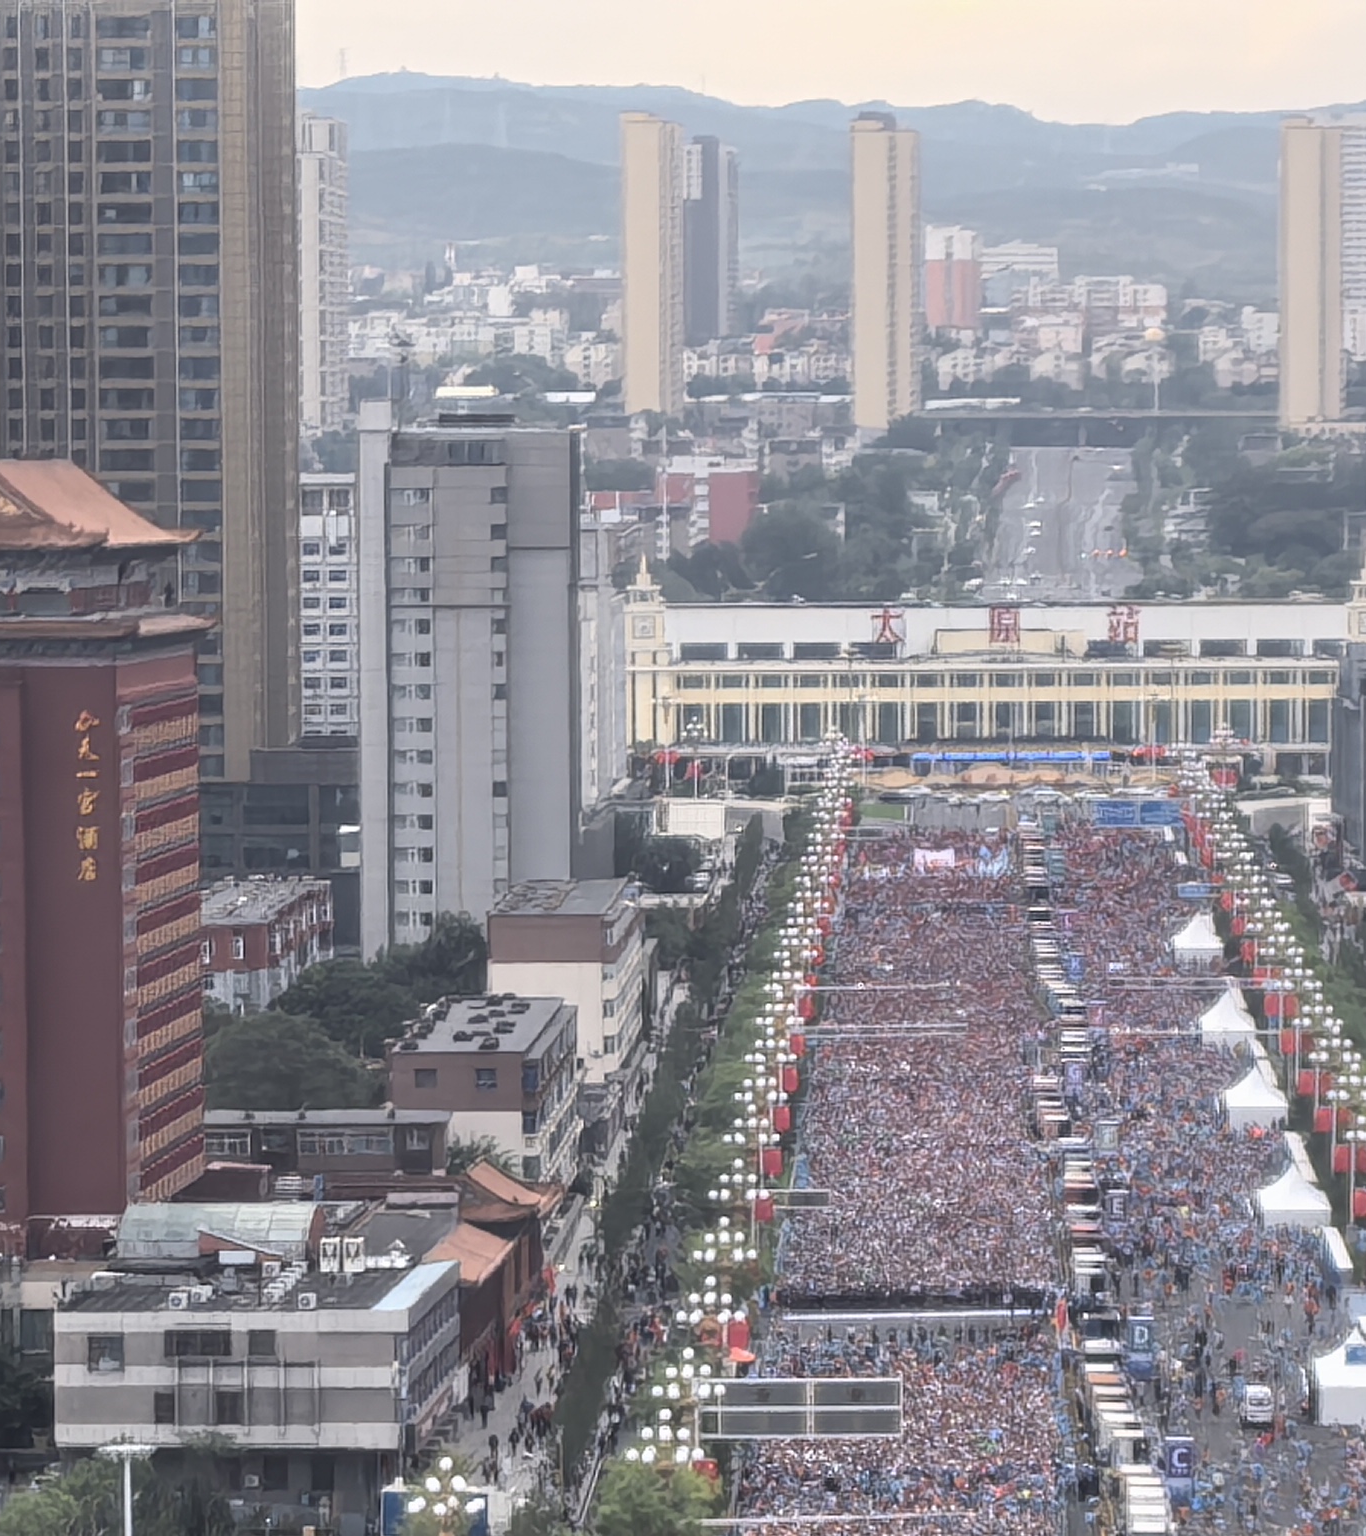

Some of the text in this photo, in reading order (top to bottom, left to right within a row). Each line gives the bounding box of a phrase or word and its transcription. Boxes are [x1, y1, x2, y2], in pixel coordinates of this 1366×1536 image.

[871, 605, 1141, 644] 太原站
[1133, 1326, 1149, 1345] D
[1171, 1448, 1189, 1468] C
